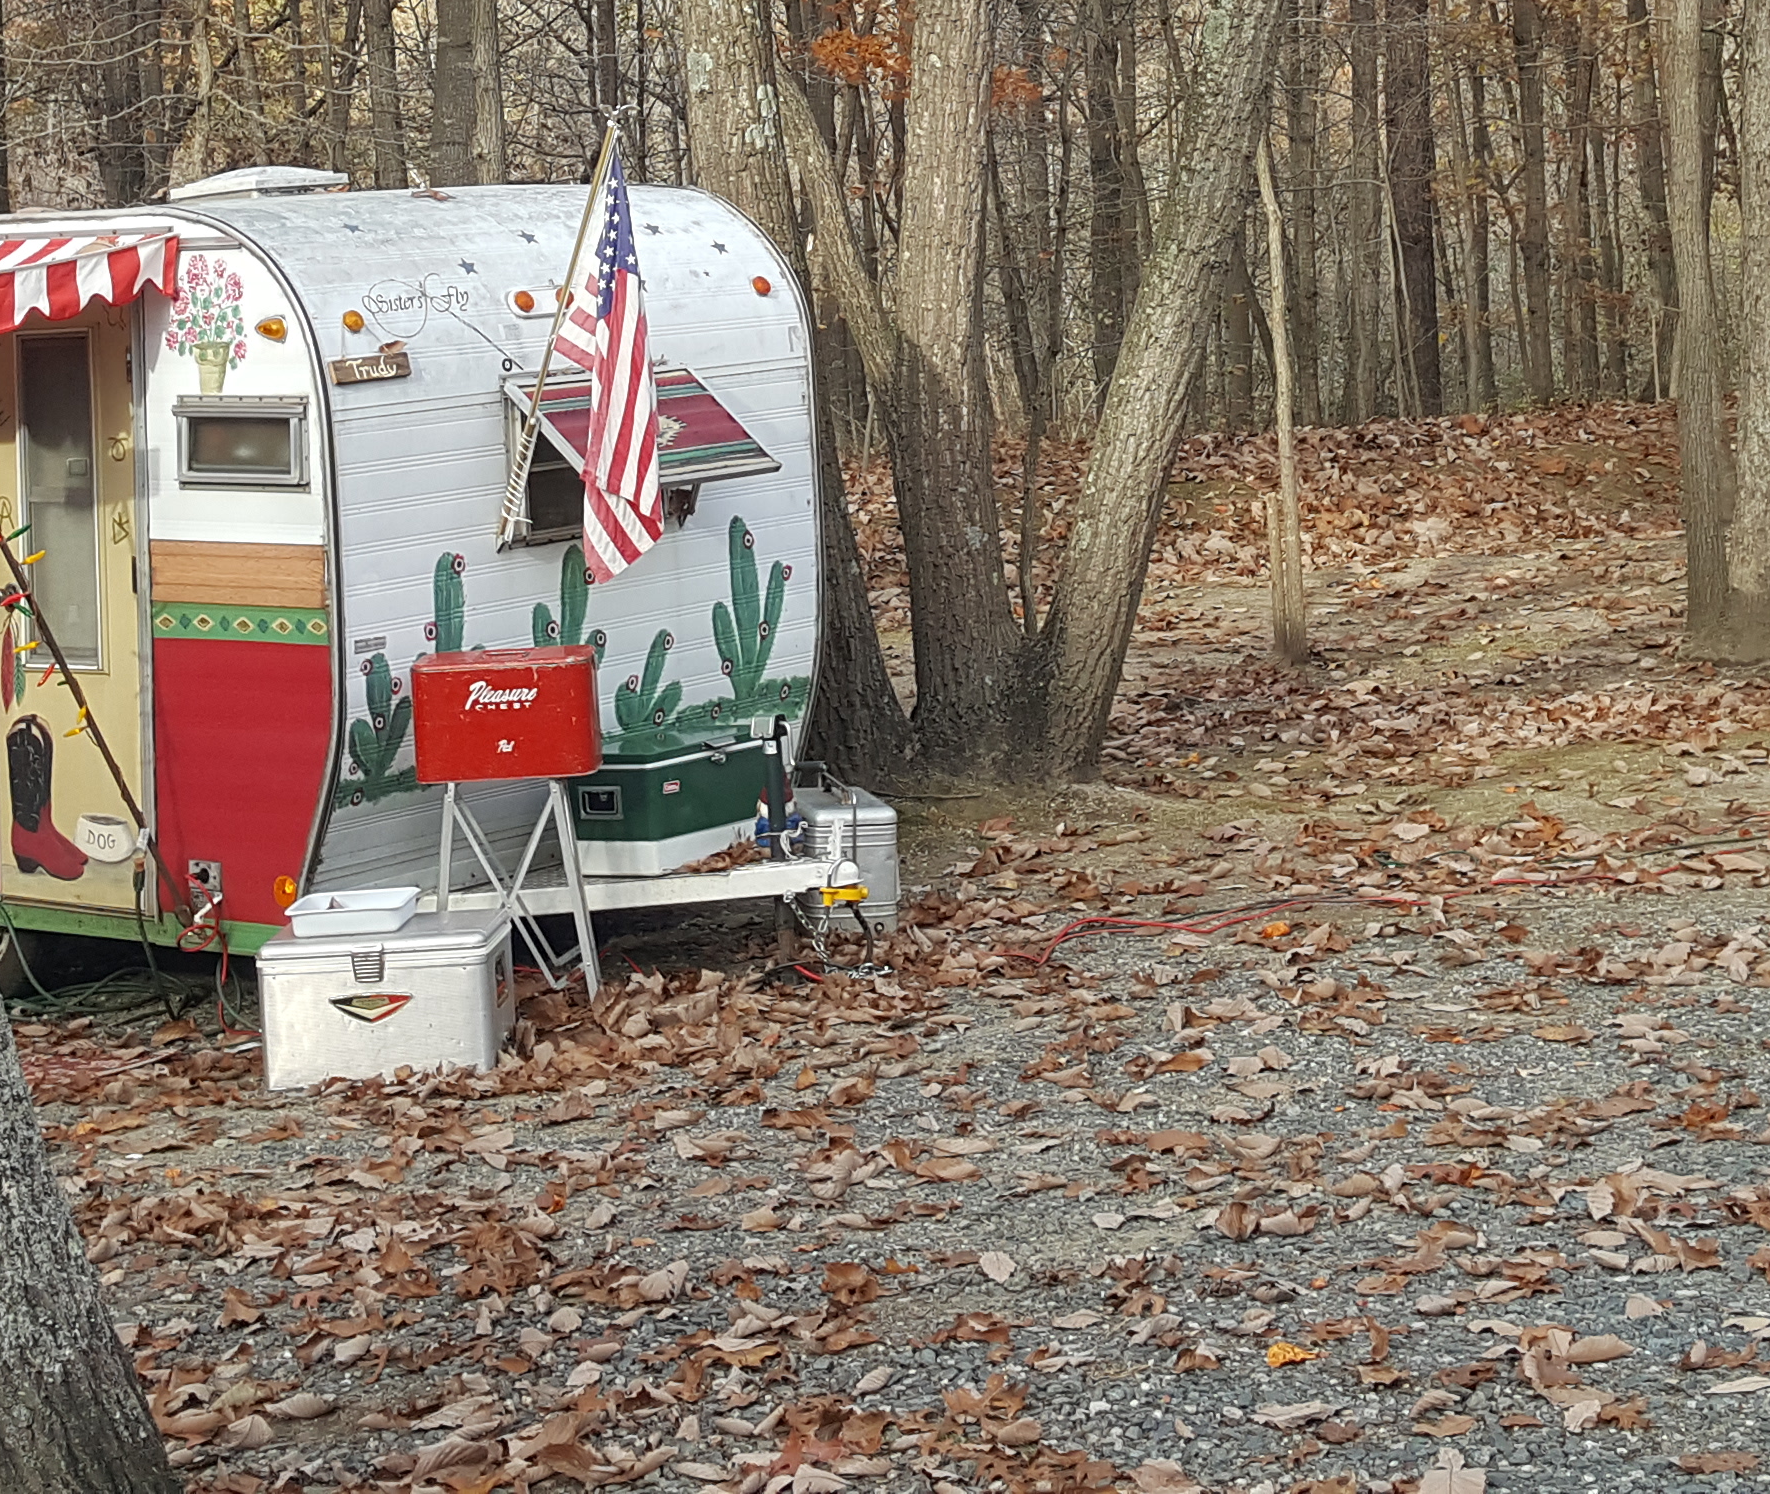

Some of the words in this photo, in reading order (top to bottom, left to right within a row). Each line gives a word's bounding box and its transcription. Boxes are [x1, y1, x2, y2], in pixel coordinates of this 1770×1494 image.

[365, 293, 424, 314] Sisters
[345, 355, 397, 380] Trudy
[464, 680, 538, 711] Pleasure
[87, 828, 117, 850] DOG
